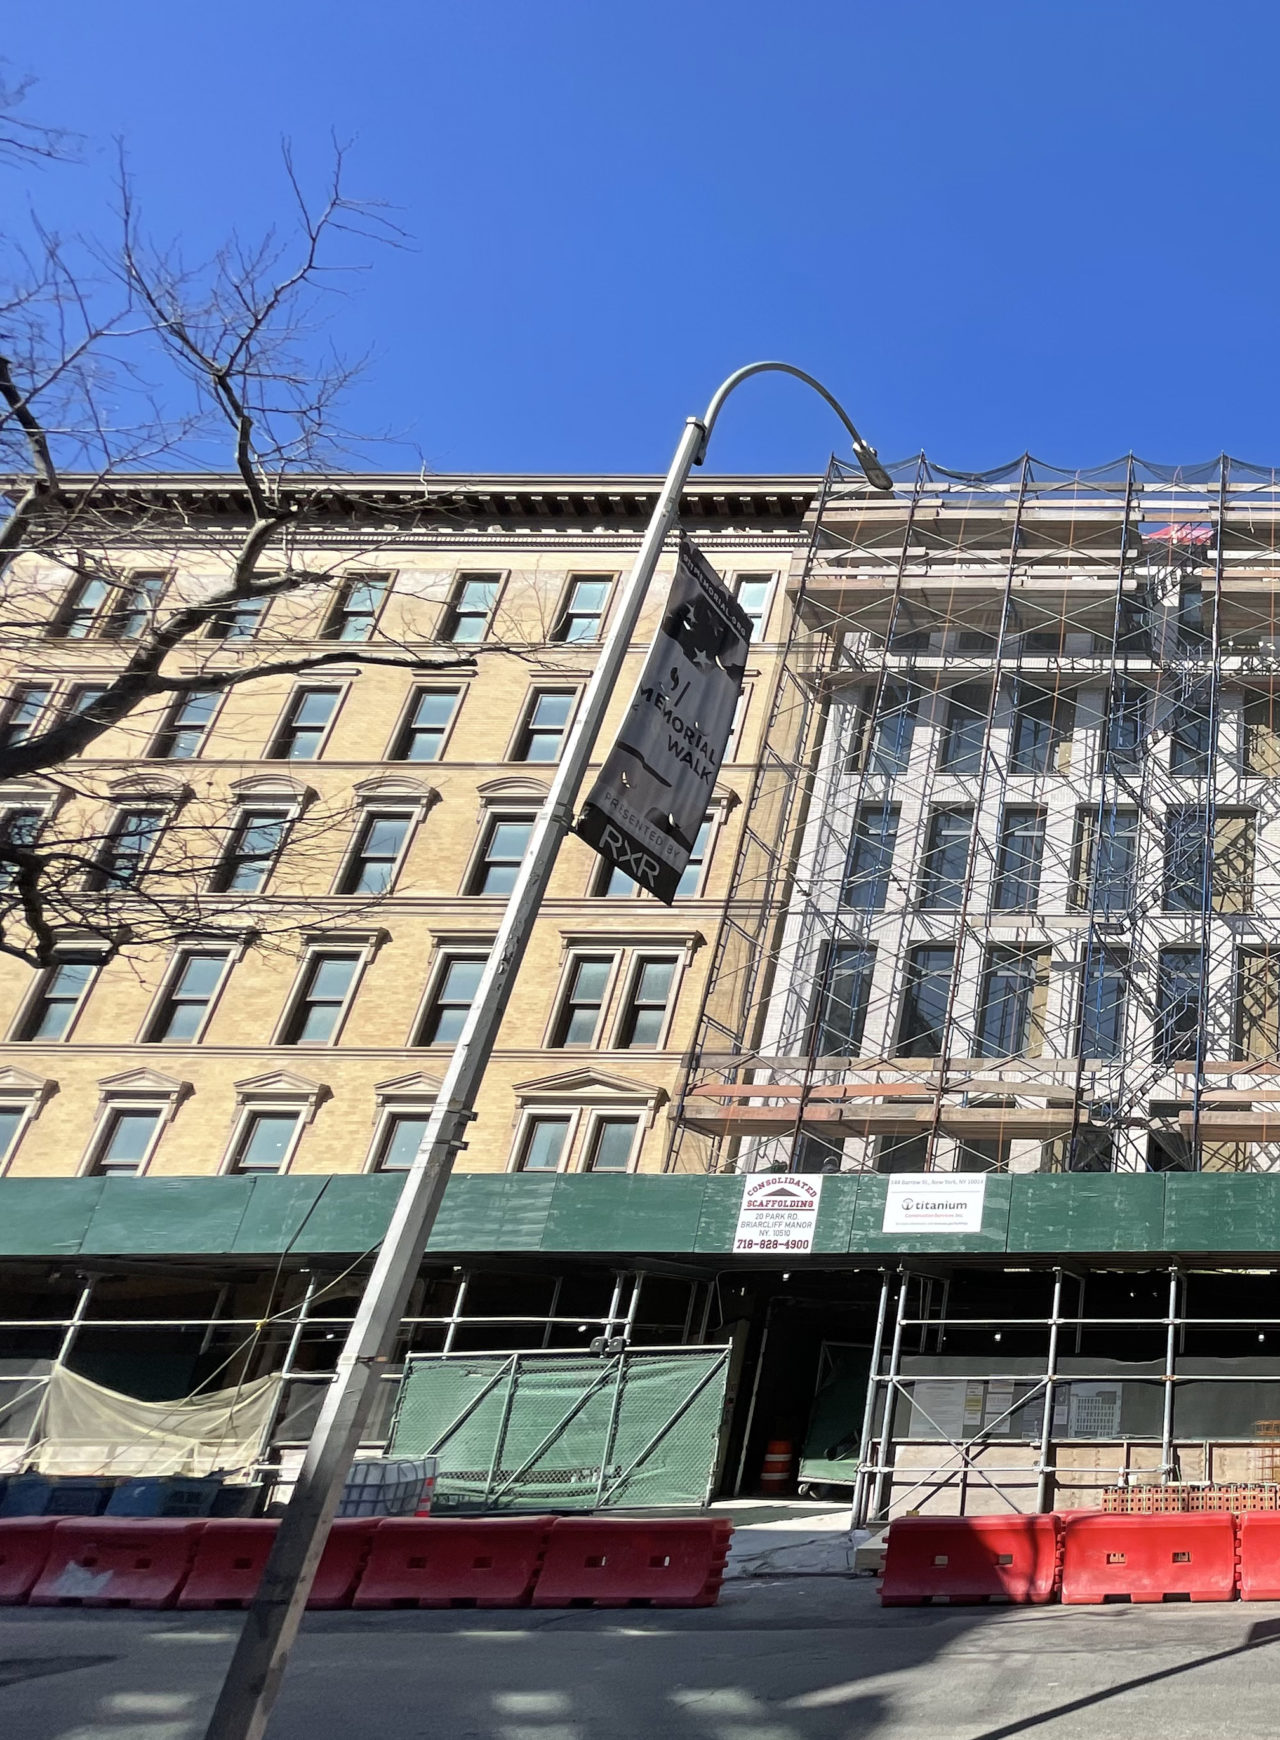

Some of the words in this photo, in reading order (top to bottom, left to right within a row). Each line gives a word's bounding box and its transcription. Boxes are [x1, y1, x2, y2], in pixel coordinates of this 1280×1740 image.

[640, 684, 716, 767] MEMORIAL
[668, 734, 713, 785] WALK
[598, 823, 660, 888] RXR
[666, 842, 681, 857] BY
[746, 1176, 818, 1198] CONSOLIDATED
[746, 1200, 814, 1208] SCAFFOLDING
[915, 1200, 968, 1210] titanium
[740, 1221, 784, 1229] BRIARCLIFF
[785, 1221, 813, 1229] MANOR
[773, 1229, 791, 1237] 10510
[736, 1239, 809, 1250] 718-828-4900
